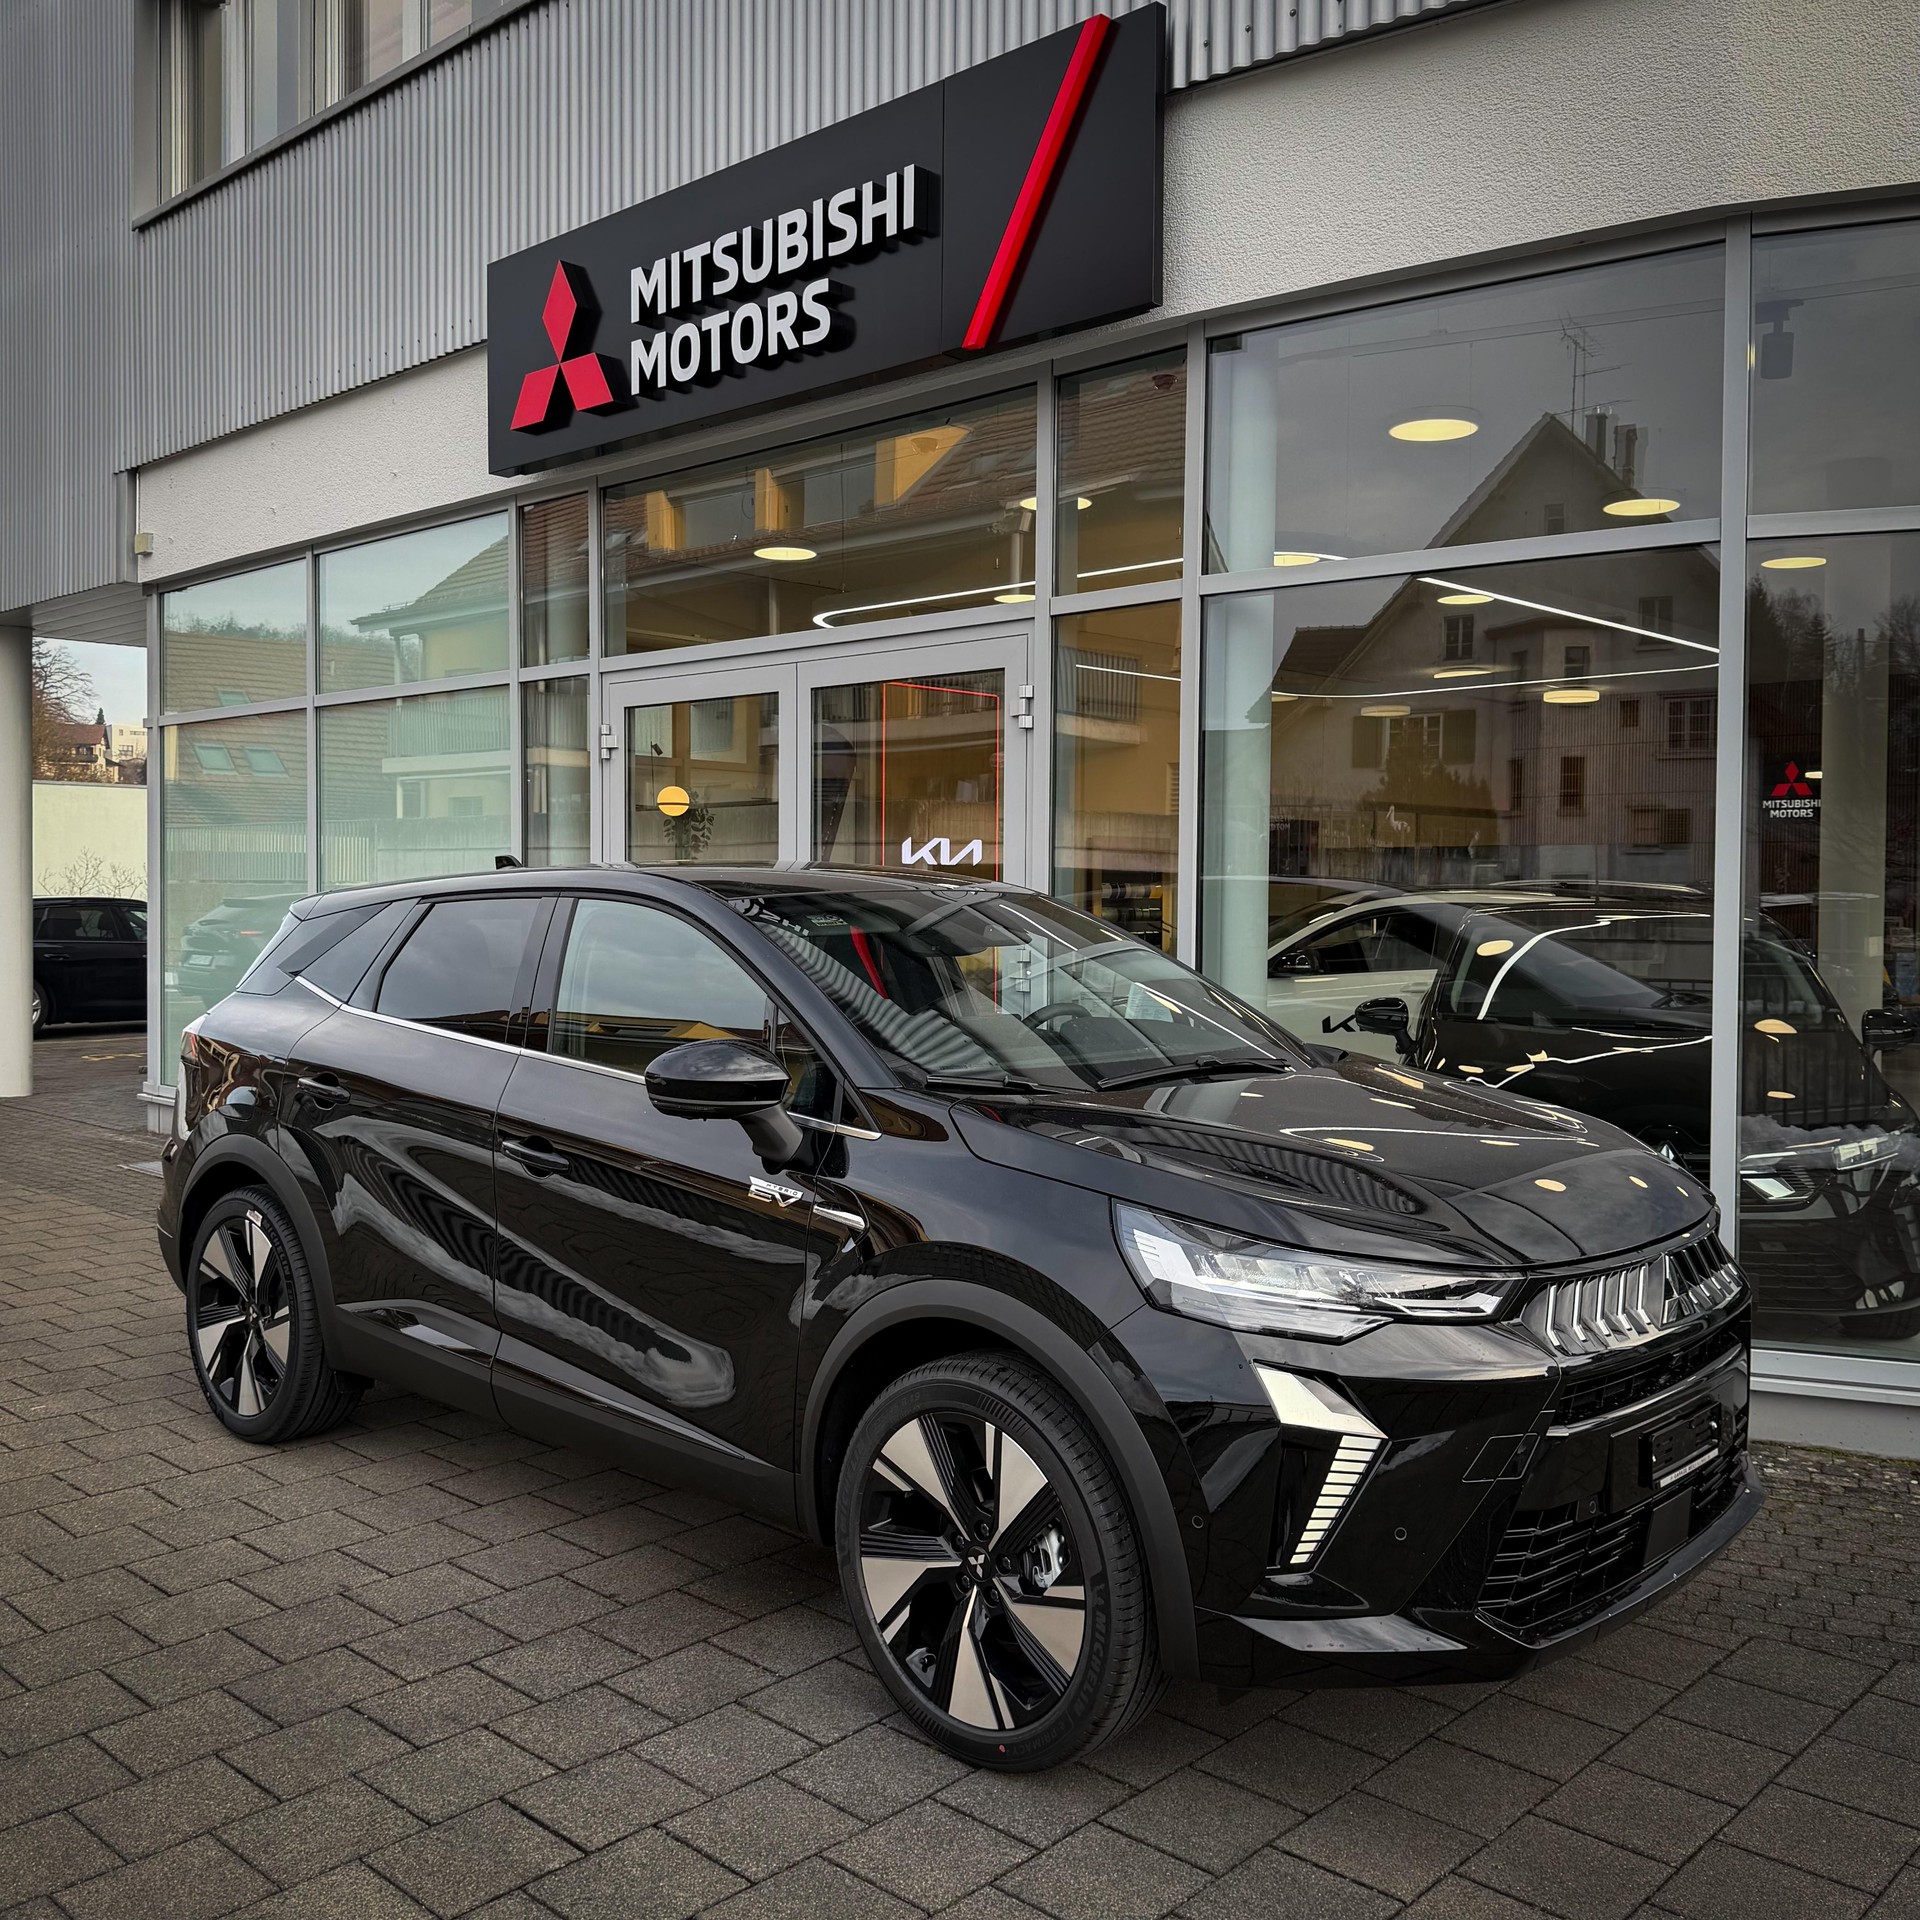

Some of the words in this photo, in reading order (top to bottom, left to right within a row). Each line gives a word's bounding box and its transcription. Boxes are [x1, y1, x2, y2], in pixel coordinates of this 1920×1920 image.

[631, 164, 915, 324] MITSUBISHI
[631, 277, 831, 396] MOTORS
[1762, 799, 1821, 809] MITSUBISHI
[1770, 809, 1813, 818] MOTORS
[901, 837, 982, 866] KIA
[262, 1220, 291, 1276] MICHELIN
[1073, 1611, 1107, 1717] MICHELIN
